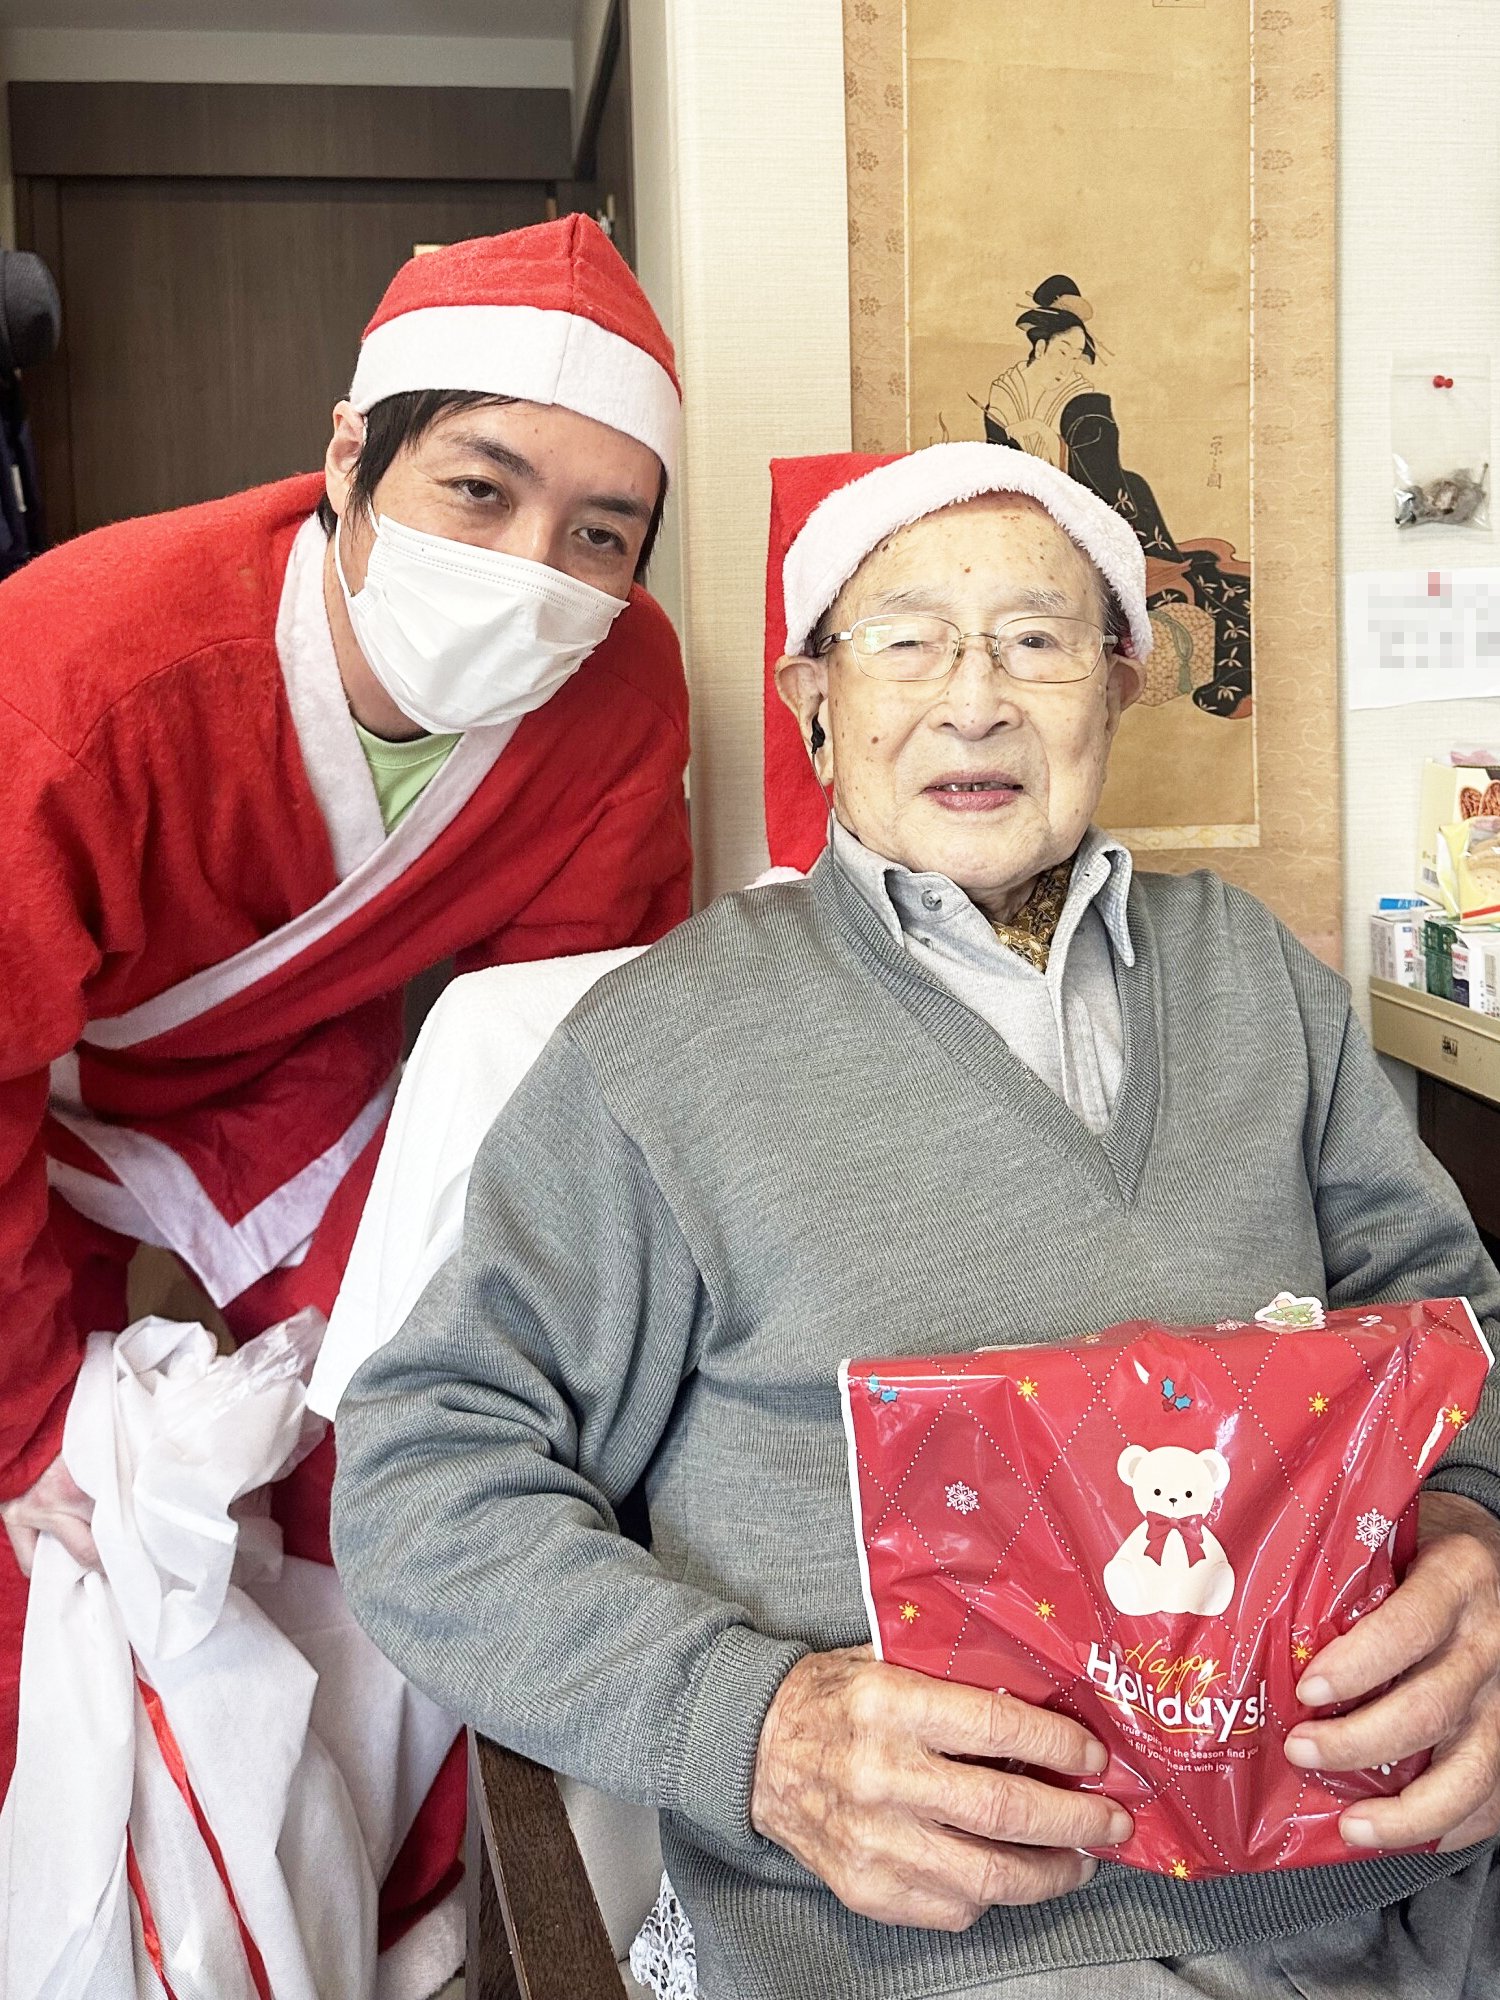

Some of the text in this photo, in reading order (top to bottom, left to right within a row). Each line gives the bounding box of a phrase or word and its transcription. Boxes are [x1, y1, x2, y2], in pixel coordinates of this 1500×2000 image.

[1086, 1641, 1267, 1743] Holidays!
[1124, 1638, 1227, 1706] Happy
[1122, 1723, 1141, 1737] true
[1163, 1745, 1172, 1755] of
[1173, 1749, 1190, 1759] the
[1190, 1750, 1225, 1760] season
[1226, 1748, 1245, 1759] find
[1135, 1742, 1147, 1754] fill
[1167, 1758, 1192, 1773] heart
[1193, 1762, 1214, 1773] with
[1215, 1762, 1234, 1774] joy.
